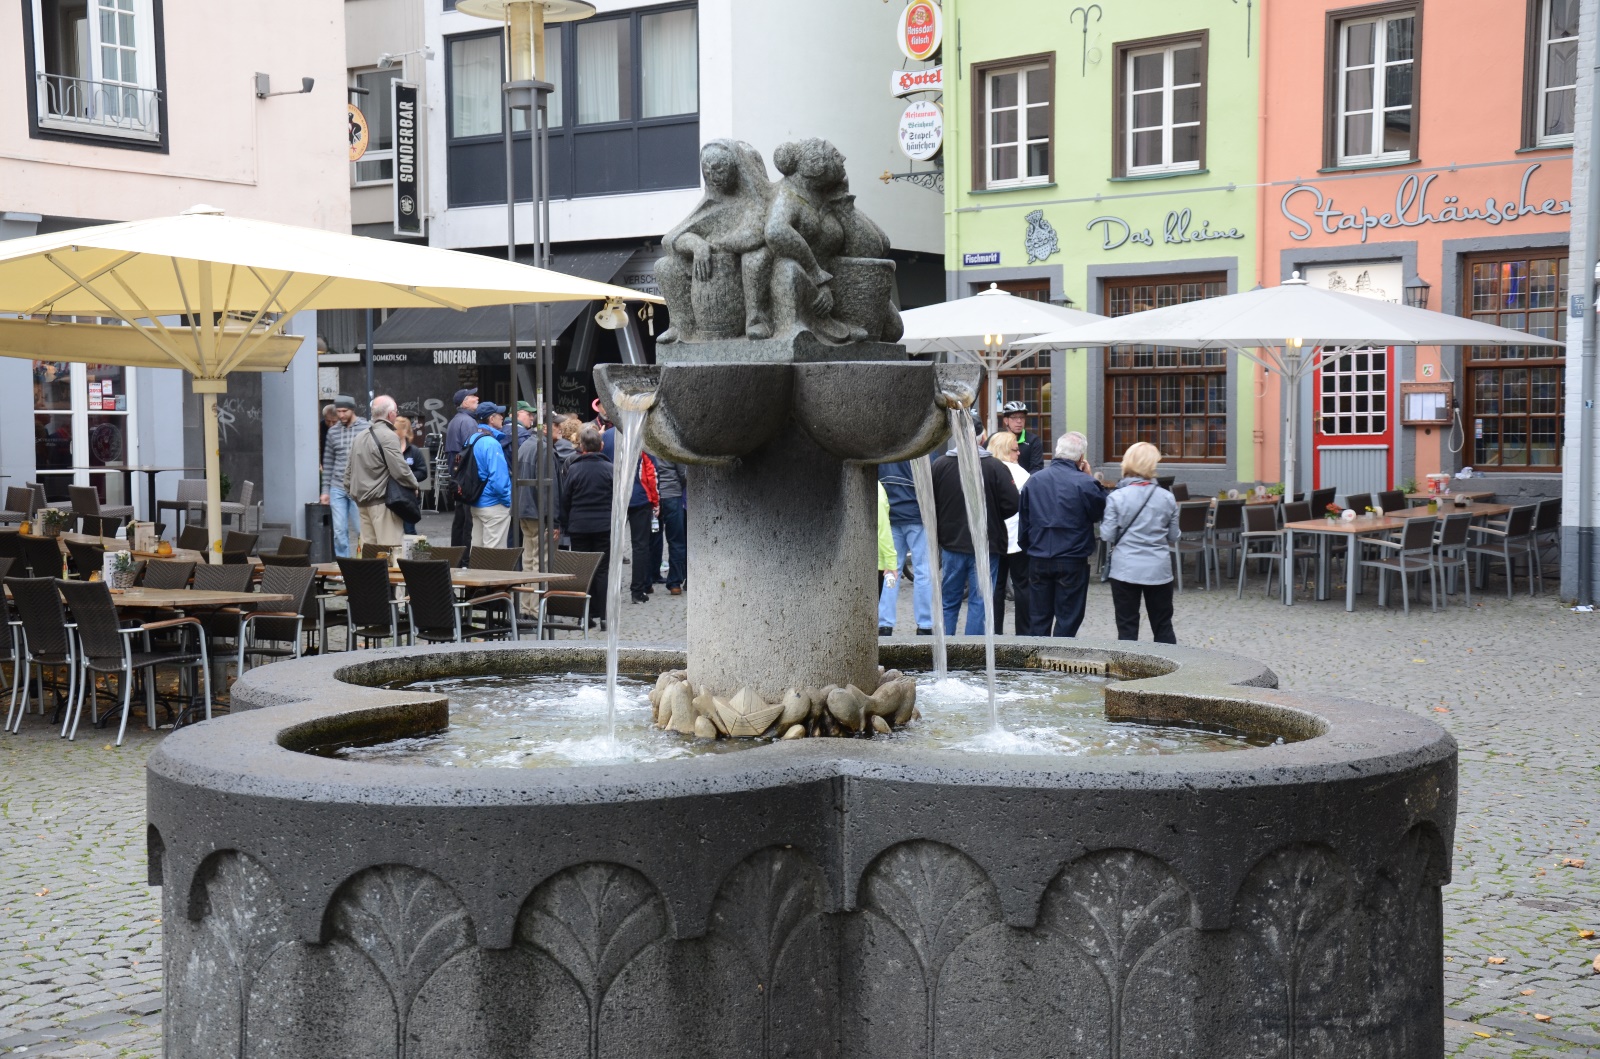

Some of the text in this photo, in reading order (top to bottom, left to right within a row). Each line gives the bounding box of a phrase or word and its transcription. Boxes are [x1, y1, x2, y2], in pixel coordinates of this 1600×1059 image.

[899, 68, 942, 90] Hotel
[400, 101, 414, 183] SONDERBAR
[1086, 207, 1245, 250] Das kleine
[965, 253, 998, 264] Fischmarkt
[373, 354, 407, 362] DOMKÖLSCH
[433, 350, 477, 364] SONDERBAR
